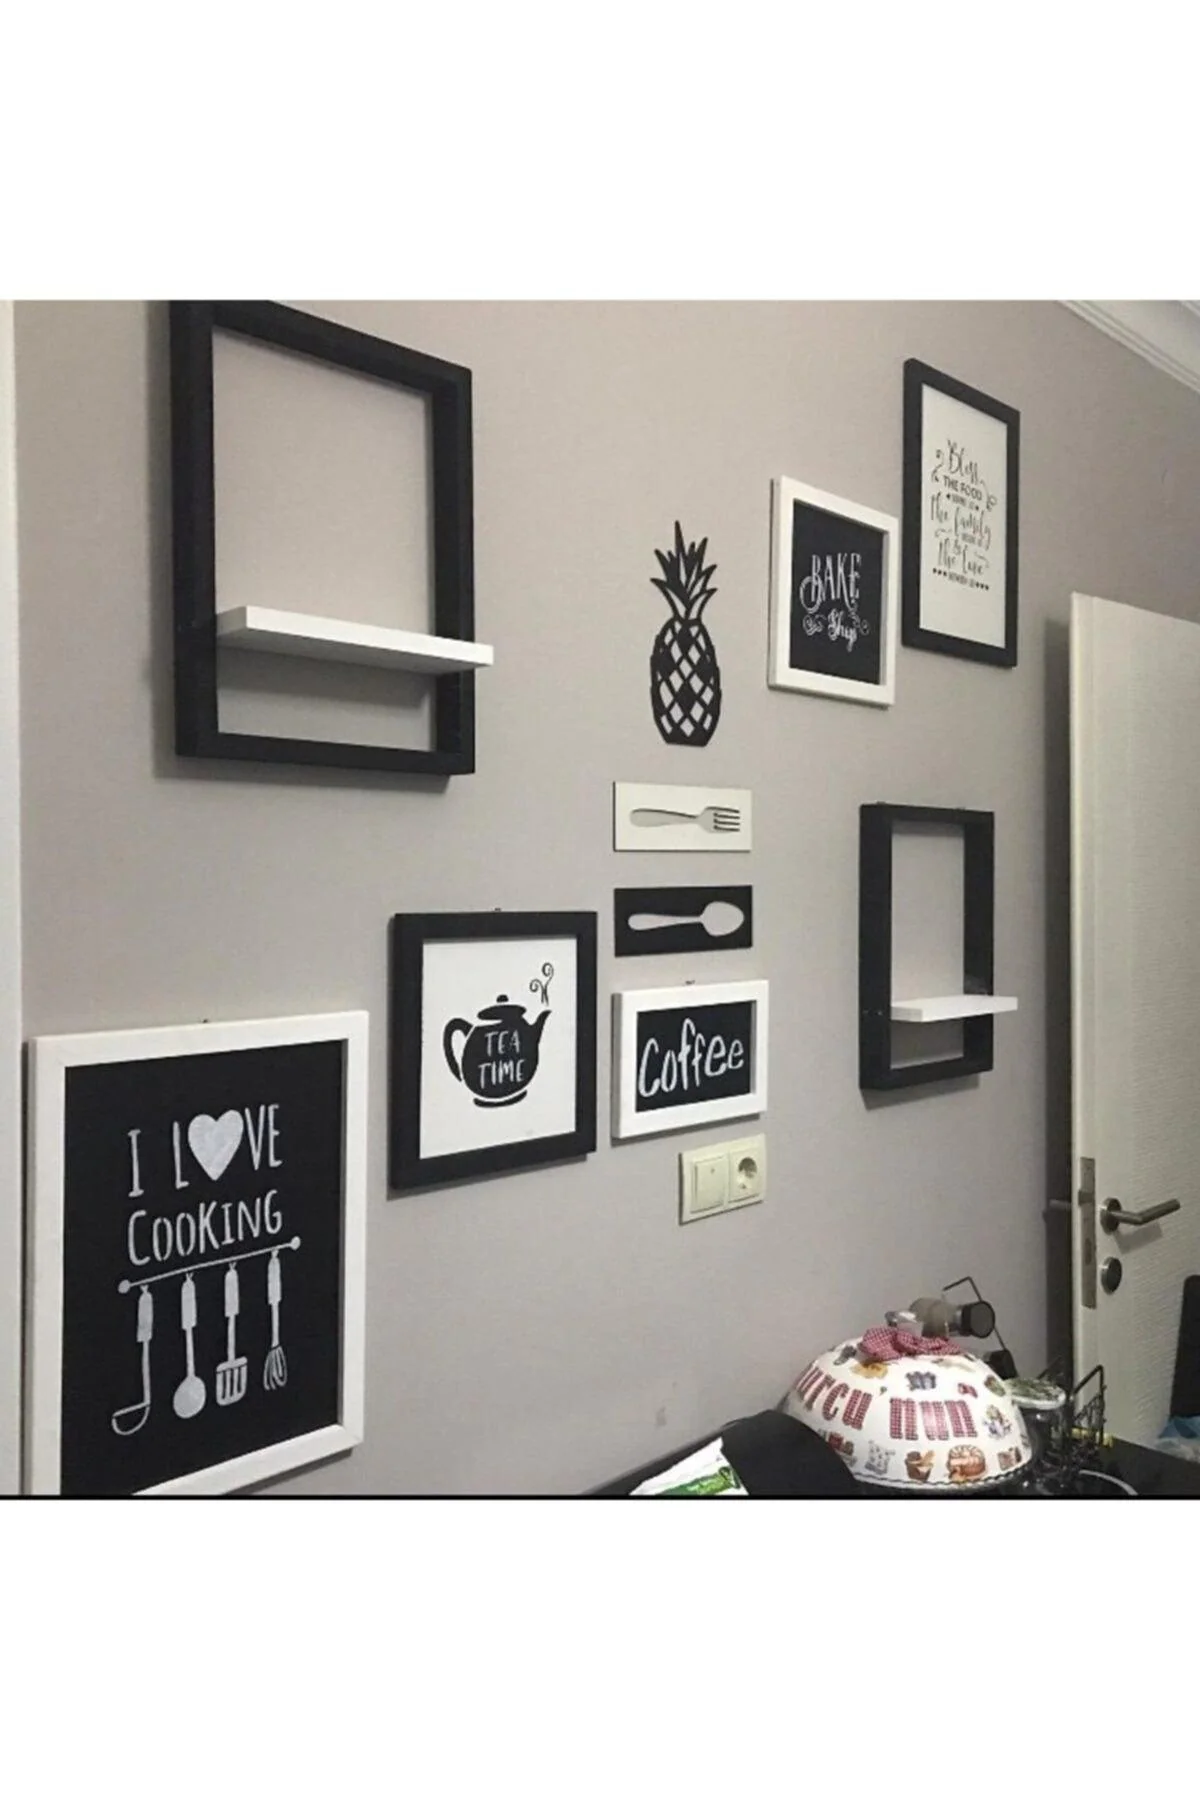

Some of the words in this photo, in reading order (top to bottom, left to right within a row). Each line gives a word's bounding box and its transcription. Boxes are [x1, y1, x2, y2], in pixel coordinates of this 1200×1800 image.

[944, 475, 959, 492] THE
[960, 482, 982, 501] FOOD
[947, 440, 978, 485] Bless
[800, 553, 861, 613] BAKE
[485, 1030, 520, 1056] TEA
[639, 1018, 744, 1097] Coffee
[478, 1059, 524, 1089] TIME
[128, 1129, 145, 1197] I
[128, 1190, 282, 1265] COOKING
